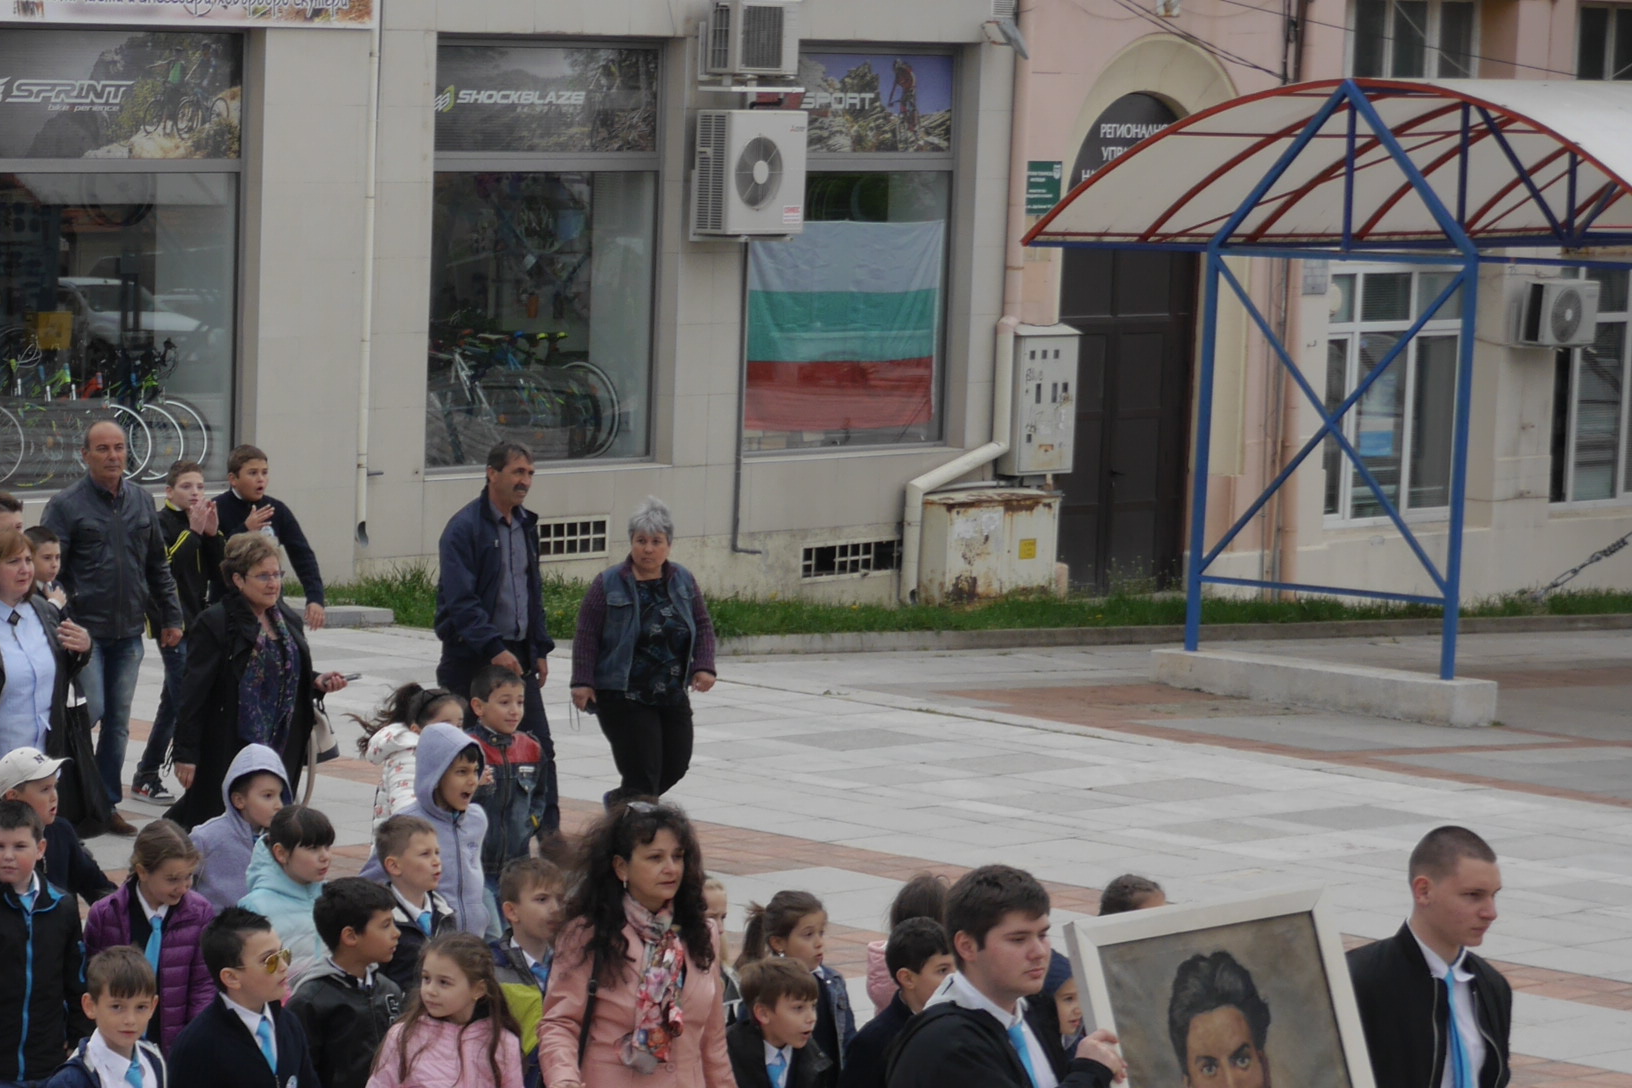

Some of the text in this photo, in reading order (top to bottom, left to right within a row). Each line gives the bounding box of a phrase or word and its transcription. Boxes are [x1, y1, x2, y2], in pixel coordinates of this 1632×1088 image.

[5, 79, 136, 103] SPRINT
[456, 90, 586, 105] SHOCKBLAZE
[799, 92, 875, 109] SPORT
